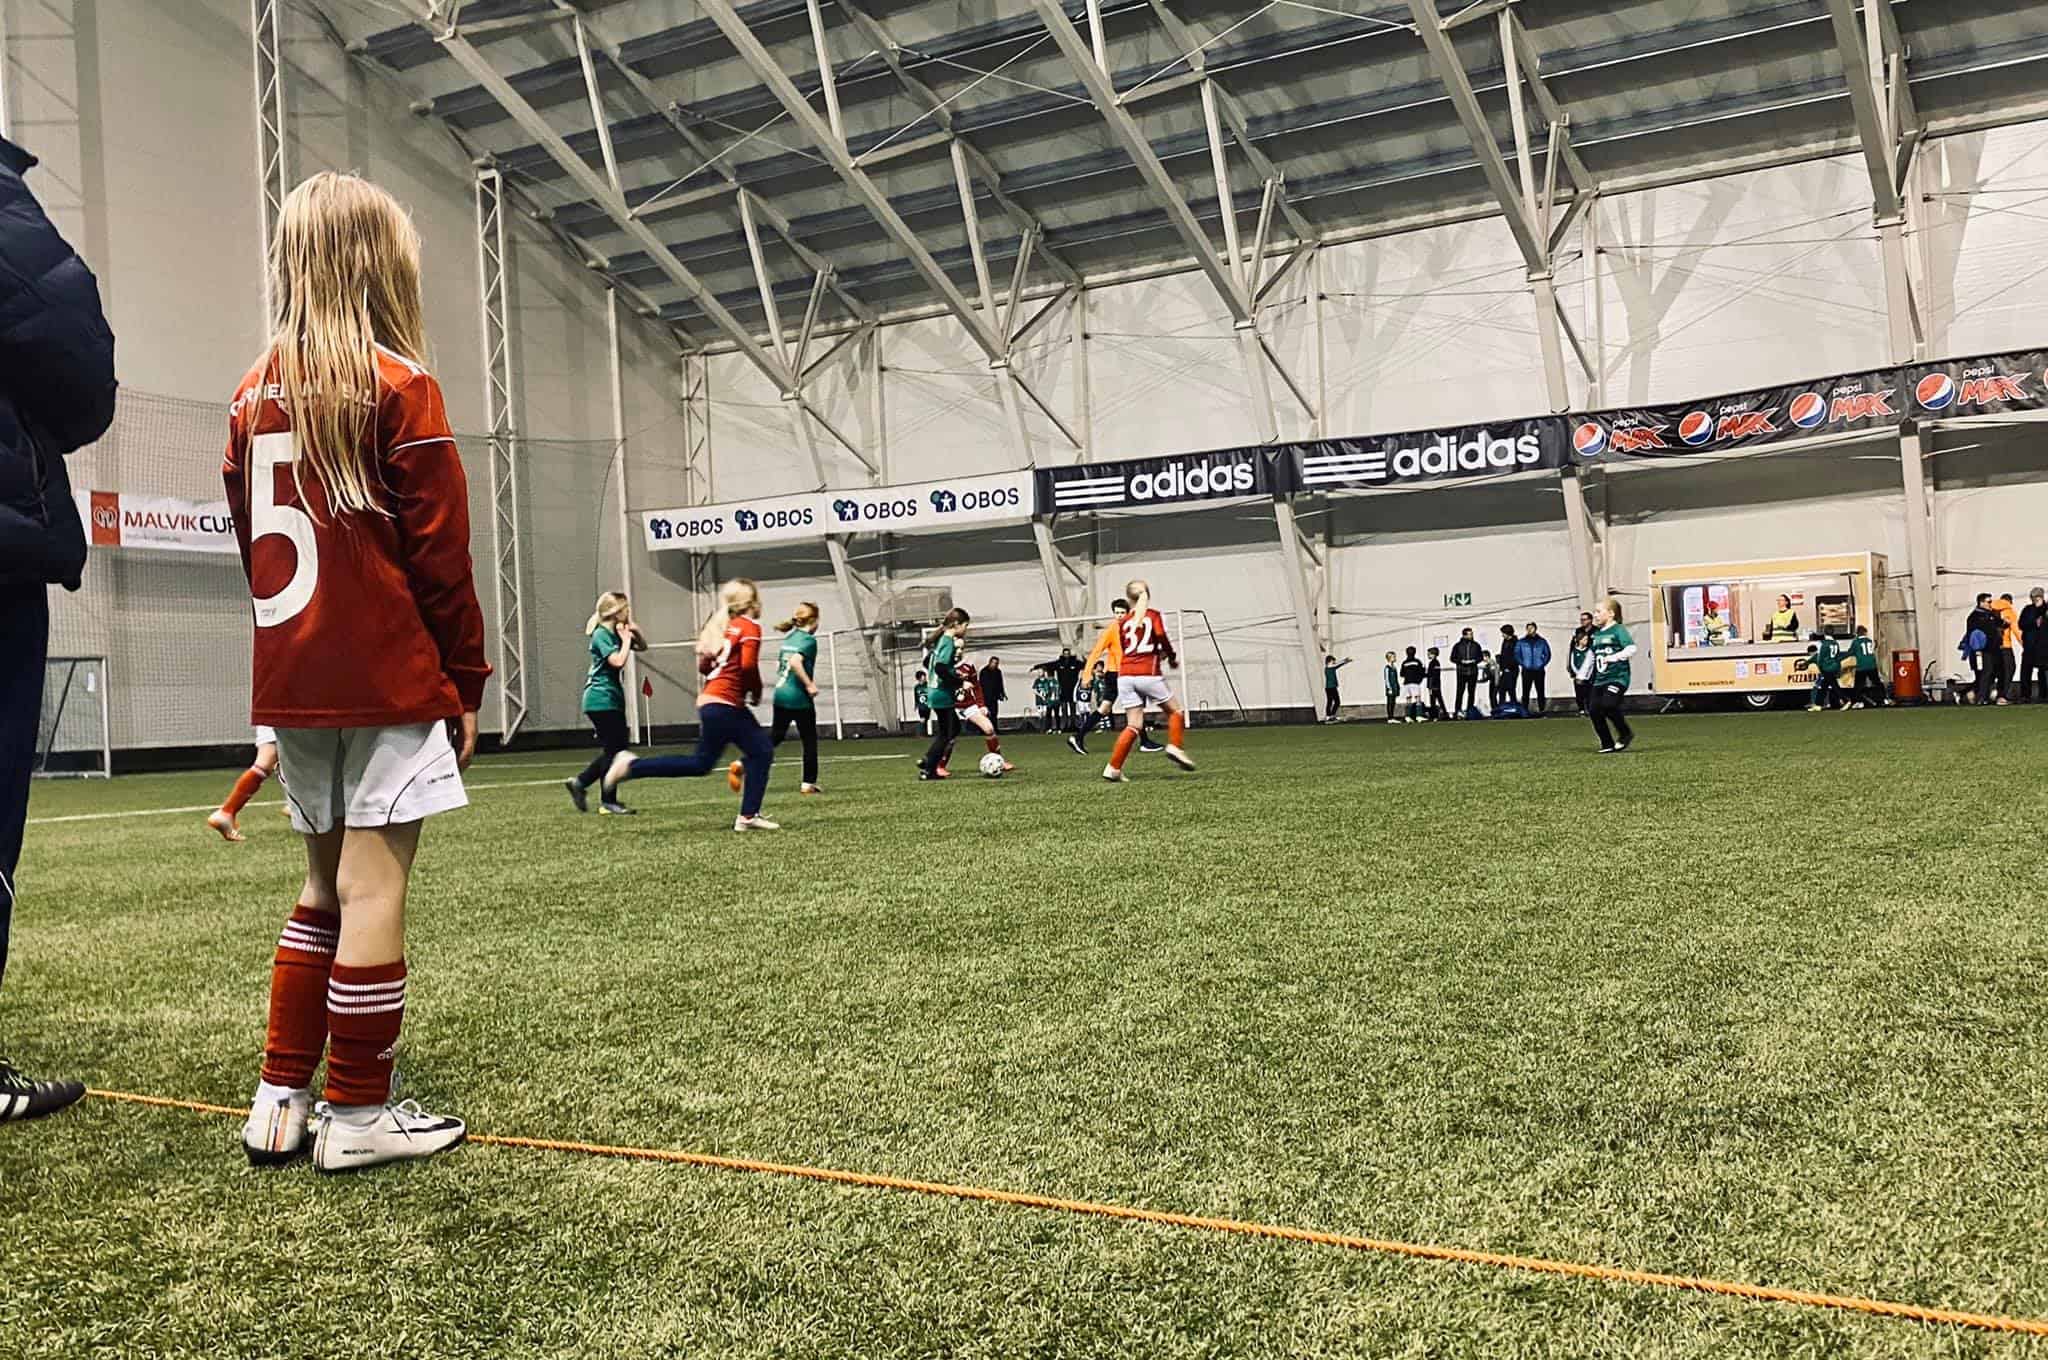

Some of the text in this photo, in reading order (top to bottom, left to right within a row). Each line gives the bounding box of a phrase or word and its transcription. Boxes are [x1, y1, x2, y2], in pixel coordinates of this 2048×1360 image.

[1962, 365, 1995, 379] pepsi
[1832, 383, 1862, 397] pepsi
[1957, 372, 2032, 405] MAX
[1719, 402, 1748, 415] pepsi
[1828, 389, 1897, 423] MAX
[1612, 417, 1638, 429] pepsi
[1716, 407, 1779, 441] MAX
[1608, 424, 1671, 452] MAX
[1393, 430, 1540, 476] adidas
[1130, 459, 1254, 501] adidas
[863, 499, 918, 520] OBOS
[962, 487, 1020, 511] OBOS
[251, 431, 318, 628] 5
[676, 518, 723, 538] OBOS
[762, 508, 813, 530] OBOS
[1123, 616, 1154, 655] 32
